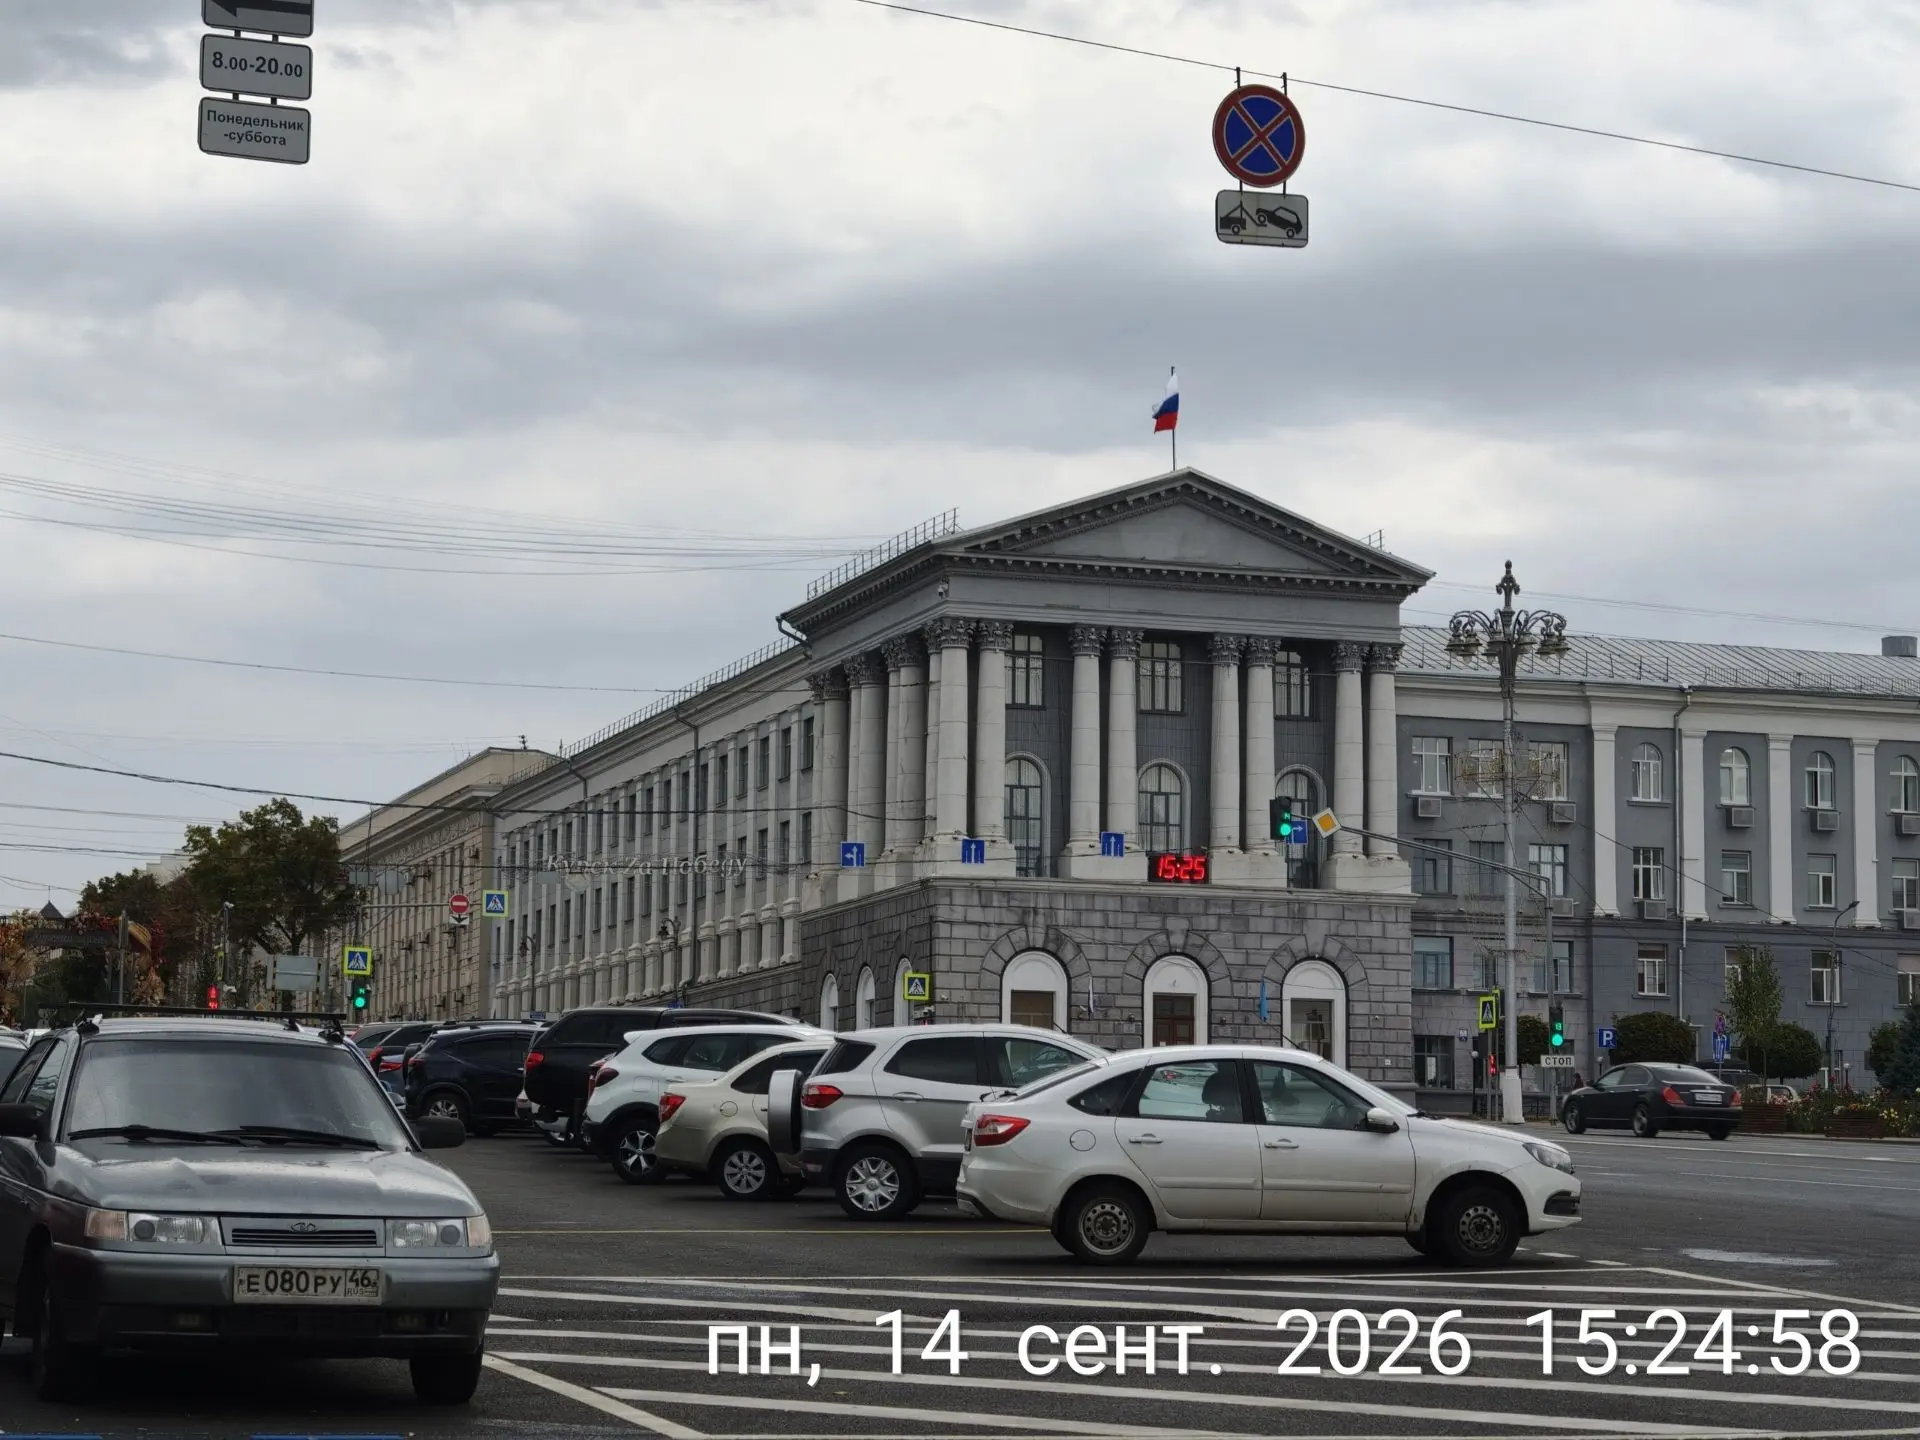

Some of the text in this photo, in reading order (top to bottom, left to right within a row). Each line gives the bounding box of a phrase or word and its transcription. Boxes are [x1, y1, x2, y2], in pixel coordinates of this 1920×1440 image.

[212, 51, 303, 78] 8.00-20.00
[207, 109, 304, 131] Понедельник
[223, 130, 286, 146] -суббота
[1158, 854, 1205, 880] 15:25
[1544, 1056, 1572, 1066] СТОП
[348, 1269, 373, 1289] 46
